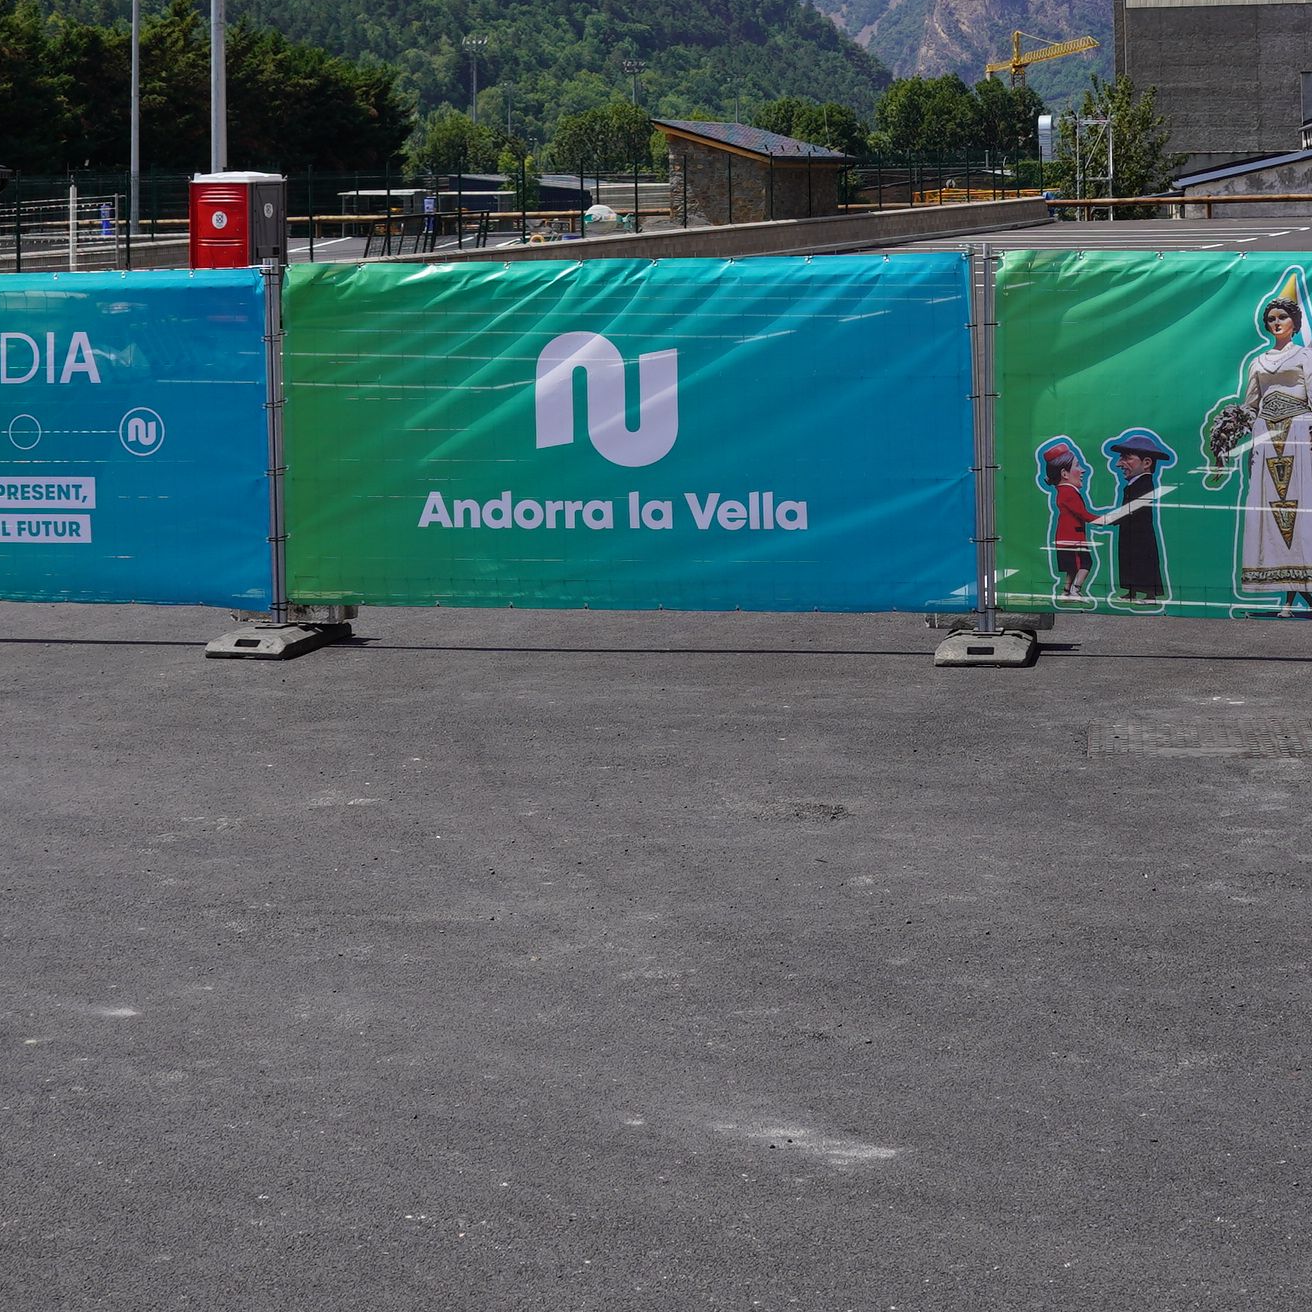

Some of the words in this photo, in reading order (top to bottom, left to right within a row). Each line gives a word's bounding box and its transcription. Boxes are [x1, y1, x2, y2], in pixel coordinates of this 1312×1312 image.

[0, 331, 102, 384] DIA
[16, 519, 81, 538] FUTUR
[418, 491, 613, 530] Andorra
[629, 491, 673, 530] la
[684, 491, 808, 530] Vella
